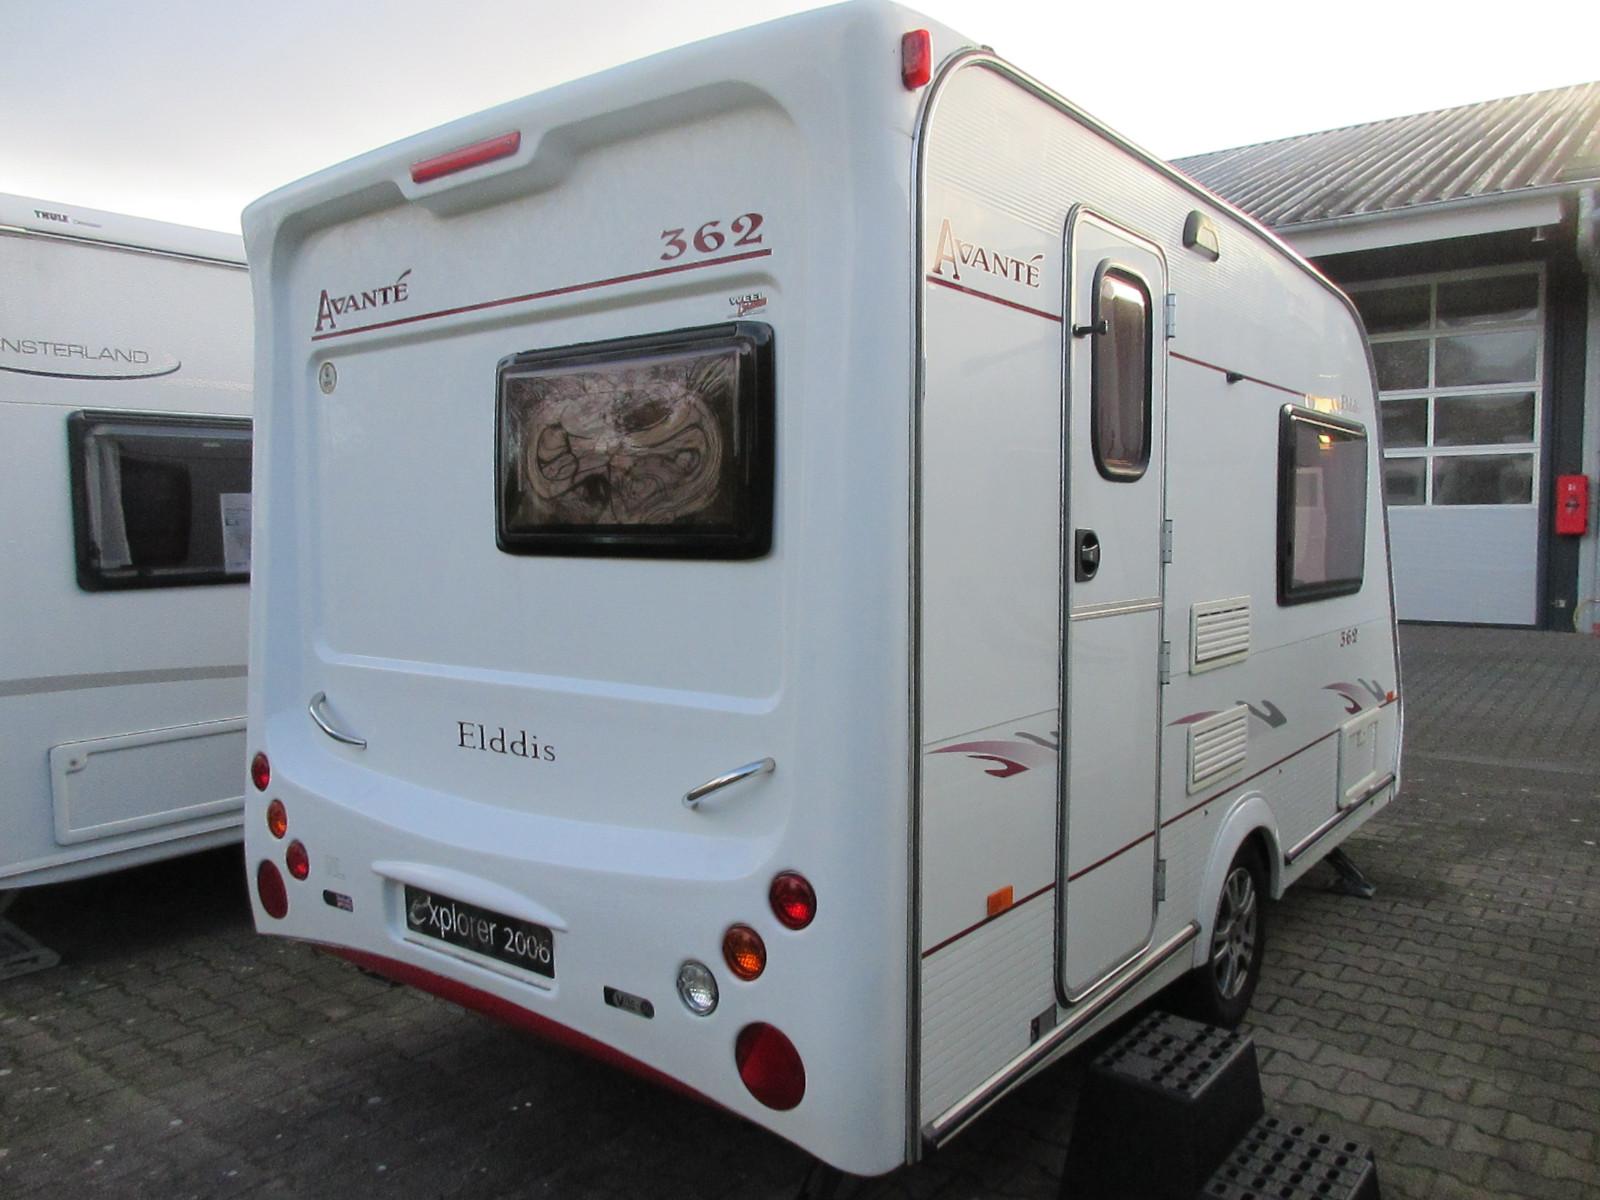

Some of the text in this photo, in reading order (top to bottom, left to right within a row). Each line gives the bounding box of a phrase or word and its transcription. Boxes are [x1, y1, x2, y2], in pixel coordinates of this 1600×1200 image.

[34, 210, 69, 223] THULE
[660, 213, 764, 260] 362
[933, 218, 1044, 289] AVANTÉ
[315, 268, 412, 331] AVANTÉ
[457, 721, 556, 761] Elddis
[503, 927, 551, 964] 2006
